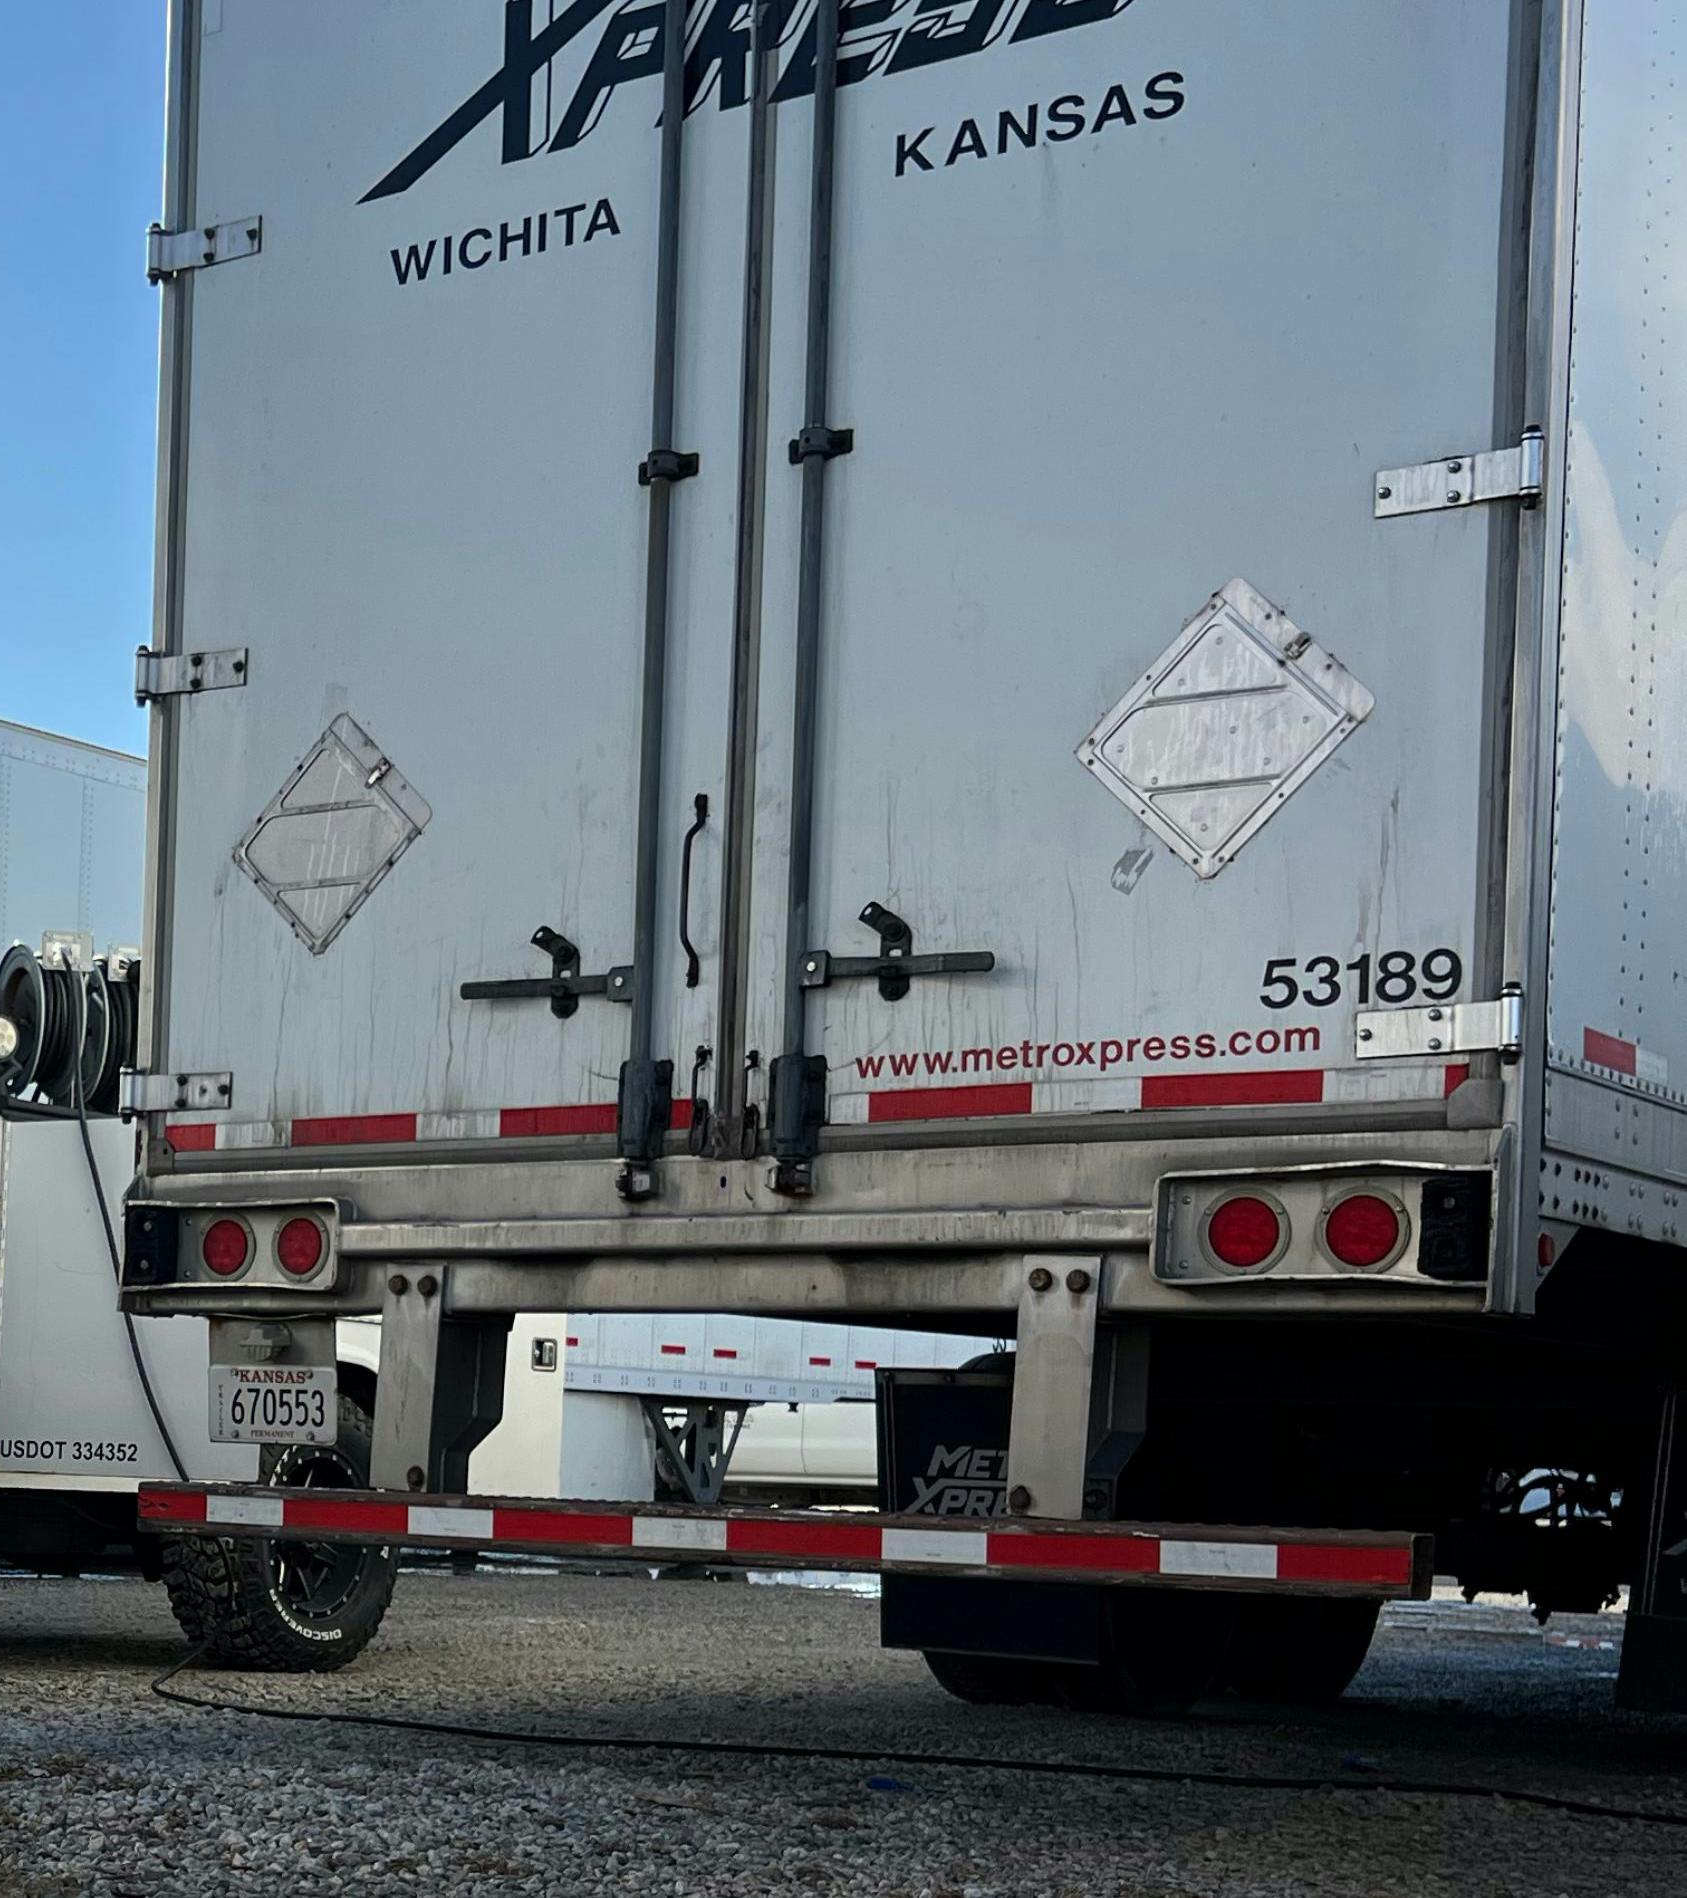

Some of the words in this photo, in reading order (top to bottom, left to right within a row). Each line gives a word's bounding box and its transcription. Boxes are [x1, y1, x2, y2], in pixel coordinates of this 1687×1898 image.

[390, 197, 622, 286] WICHITA
[893, 70, 1187, 177] KANSAS
[1260, 948, 1463, 1009] 53189
[855, 1025, 1321, 1079] www.metroxpress.com
[238, 1369, 306, 1384] KANSAS
[231, 1388, 325, 1427] 670553
[0, 1440, 67, 1460] USDOT
[71, 1441, 138, 1462] 334352
[250, 1429, 296, 1439] PERMANENT
